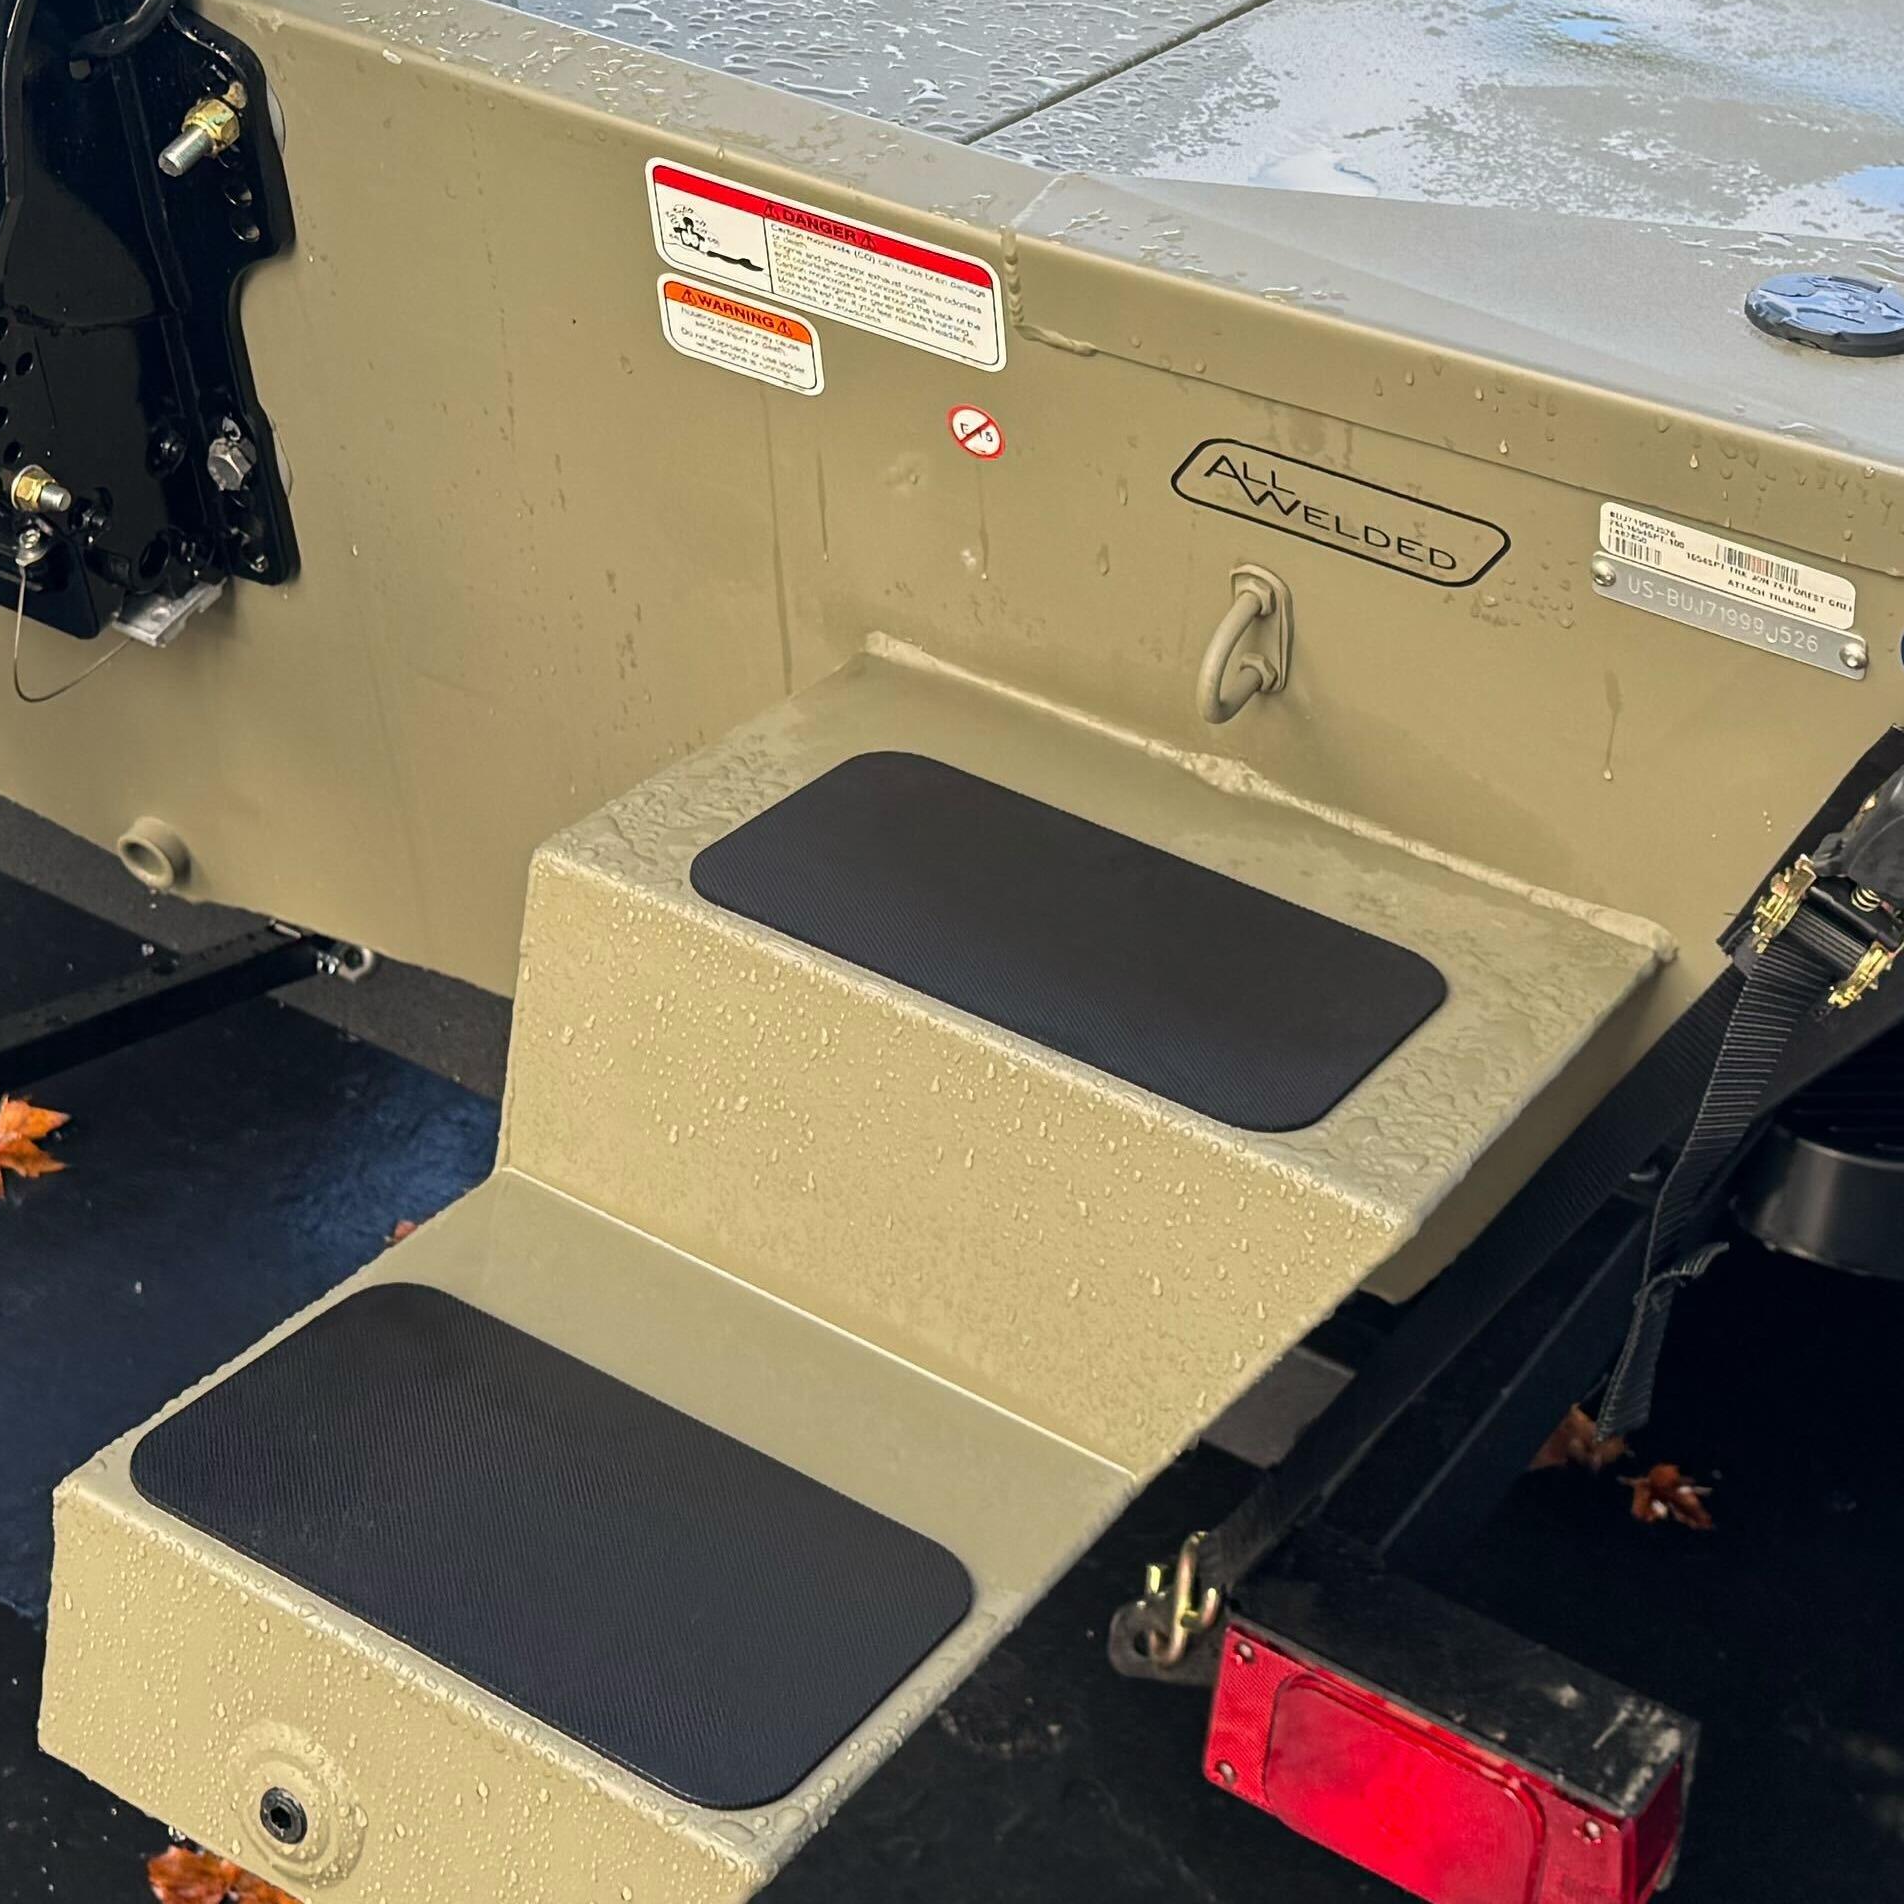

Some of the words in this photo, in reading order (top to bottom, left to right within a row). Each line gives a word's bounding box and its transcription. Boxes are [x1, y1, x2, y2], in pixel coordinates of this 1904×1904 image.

[783, 210, 857, 242] DANGER
[698, 295, 774, 329] WARNING
[1203, 455, 1295, 496] ALL
[1238, 476, 1456, 570] WELDED
[1628, 576, 1818, 653] US-BUJ71999J526
